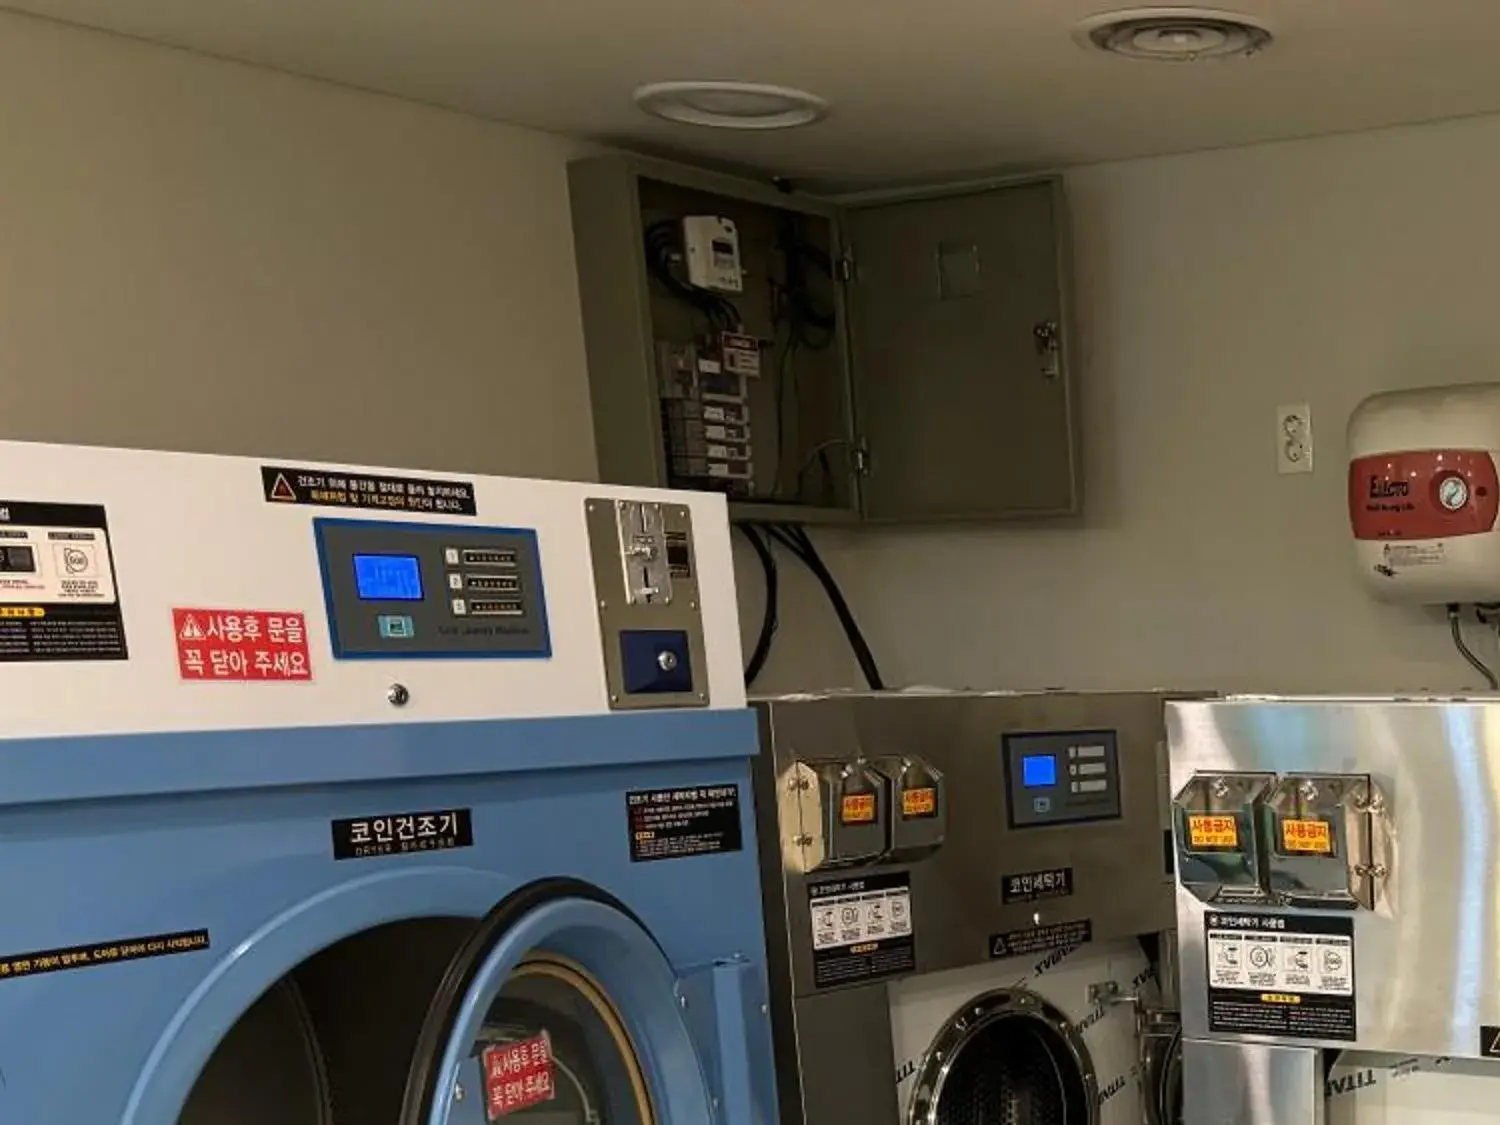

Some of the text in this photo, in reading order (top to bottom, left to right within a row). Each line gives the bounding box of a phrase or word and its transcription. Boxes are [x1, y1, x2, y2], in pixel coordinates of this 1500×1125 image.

[207, 614, 303, 643] 사용후 문을
[185, 649, 308, 677] 꼭 닫아 주세요
[351, 812, 457, 842] 코인건조기
